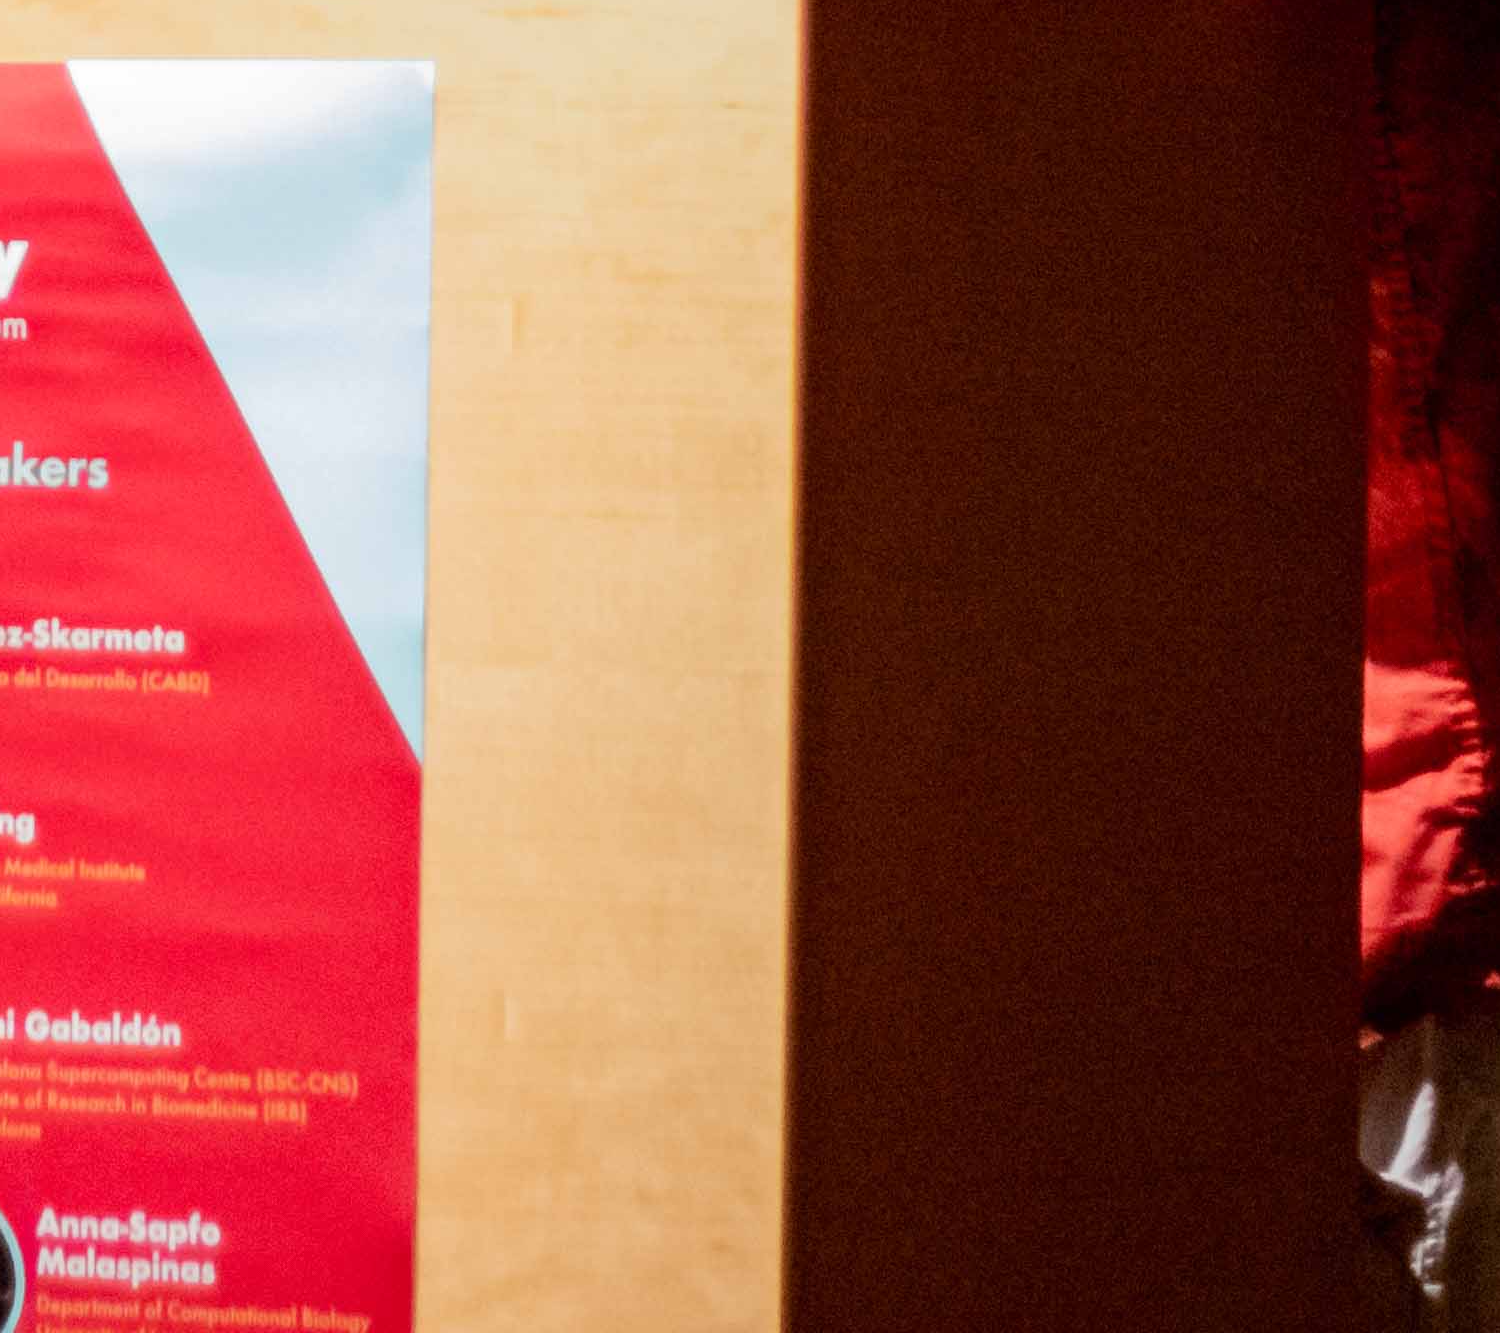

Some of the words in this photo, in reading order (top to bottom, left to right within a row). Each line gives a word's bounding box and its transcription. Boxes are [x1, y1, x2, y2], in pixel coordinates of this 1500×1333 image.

[14, 666, 41, 688] del
[4, 857, 74, 879] Medical
[25, 1010, 181, 1046] Gabaldón
[24, 1091, 42, 1110] of
[47, 1091, 126, 1115] Research
[131, 1095, 147, 1115] in
[37, 1207, 221, 1252] Anna-Sapfo
[37, 1246, 216, 1289] Malaspinas
[144, 1297, 162, 1317] of
